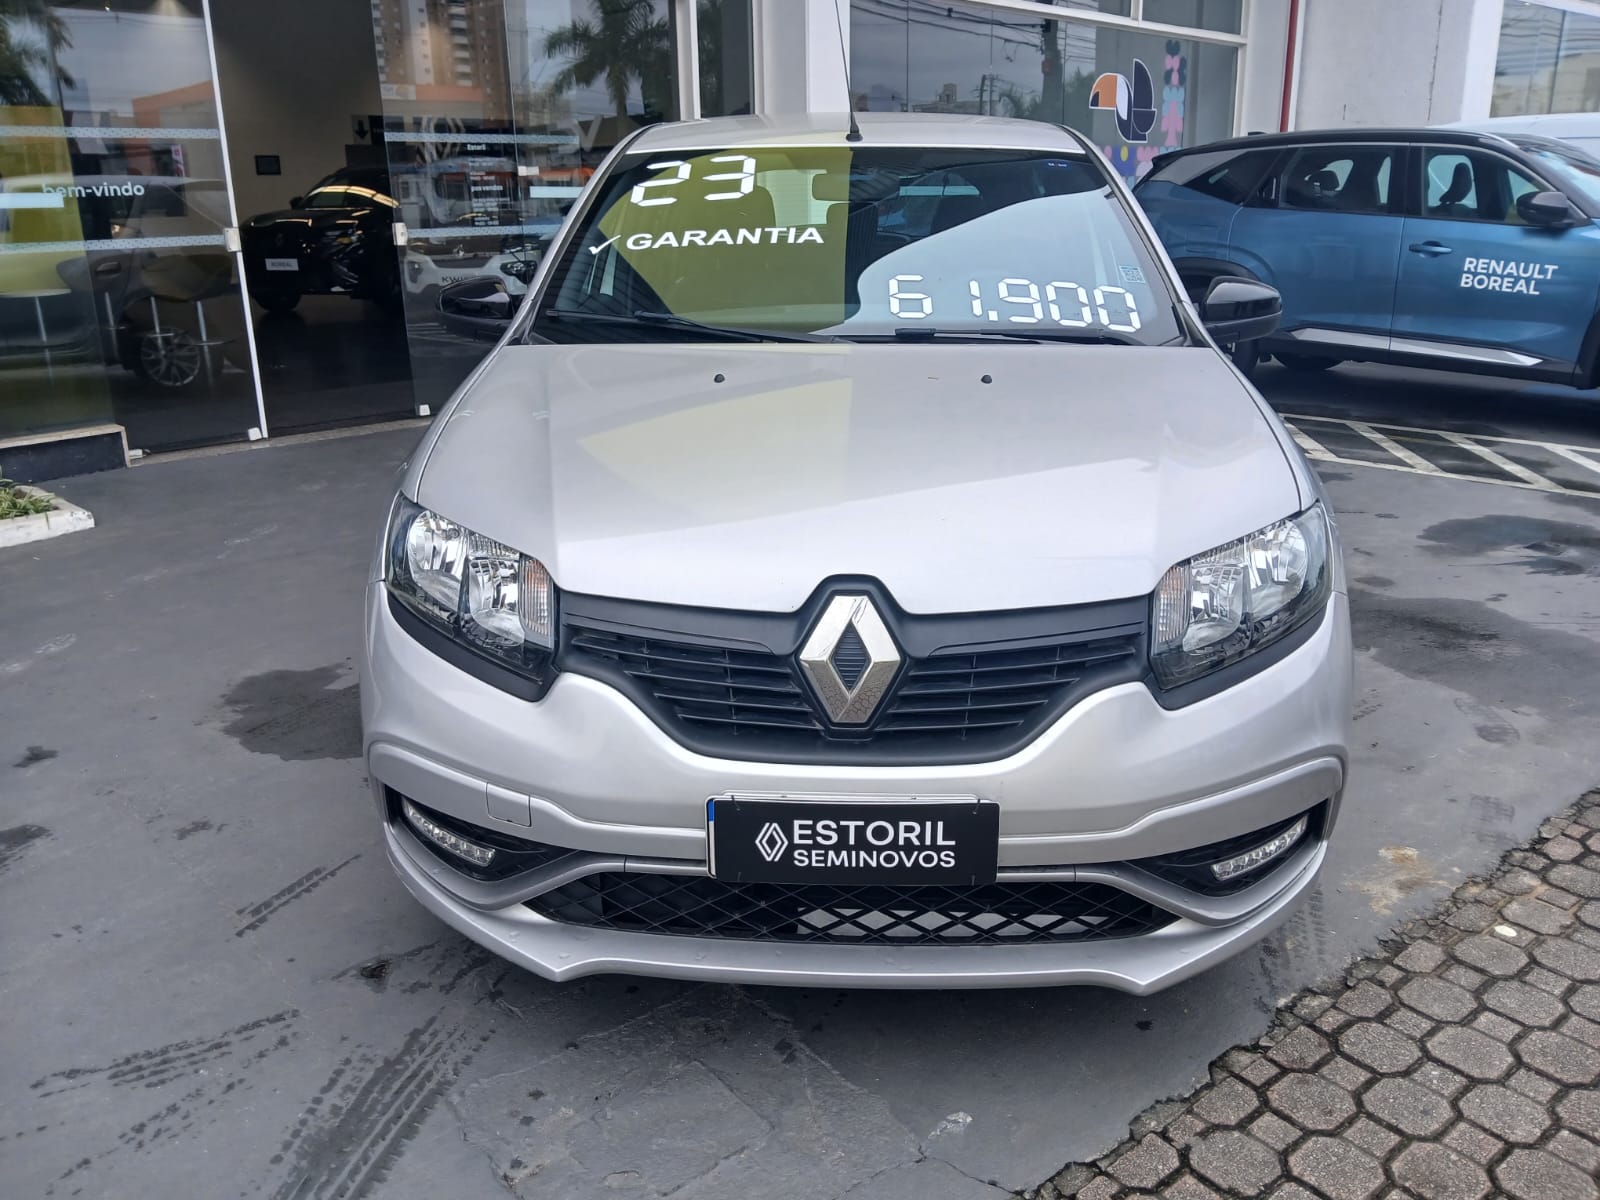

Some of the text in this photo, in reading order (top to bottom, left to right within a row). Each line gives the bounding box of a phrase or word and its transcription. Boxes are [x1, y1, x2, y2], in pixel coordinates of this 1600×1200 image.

[42, 181, 145, 198] bem-vindo
[630, 155, 757, 207] 23
[626, 227, 825, 250] GARANTIA
[1463, 257, 1559, 280] RENAULT
[1460, 273, 1541, 296] BOREAL
[793, 819, 956, 846] ESTORIL
[793, 849, 956, 868] SEMINOVOS
